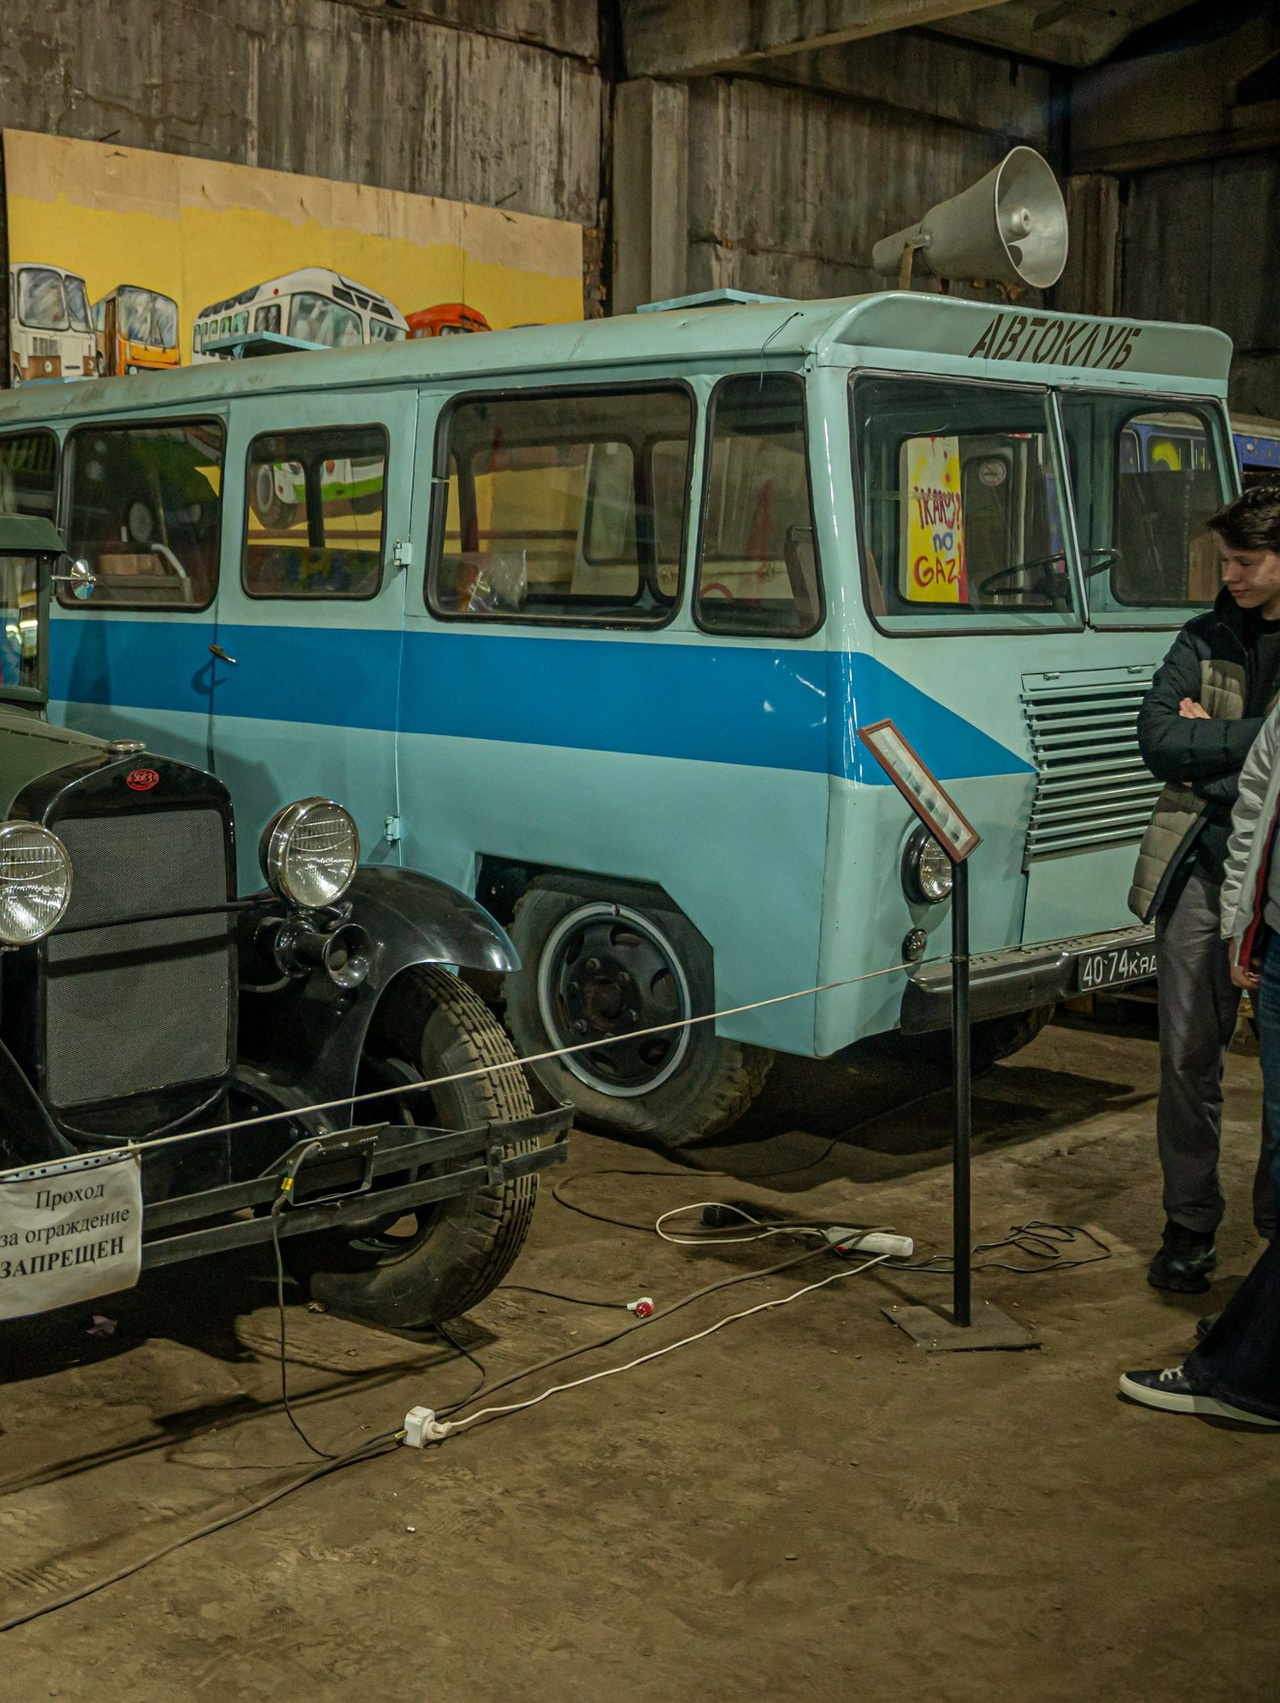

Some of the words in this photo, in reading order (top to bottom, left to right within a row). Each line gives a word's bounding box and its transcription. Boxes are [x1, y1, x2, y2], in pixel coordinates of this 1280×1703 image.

[968, 313, 1142, 369] АВТОКЛУБ
[35, 1184, 104, 1211] Проход
[0, 1233, 18, 1248] за
[25, 1208, 130, 1245] ограждение
[0, 1236, 124, 1279] ЗАПРЕЩЕН
